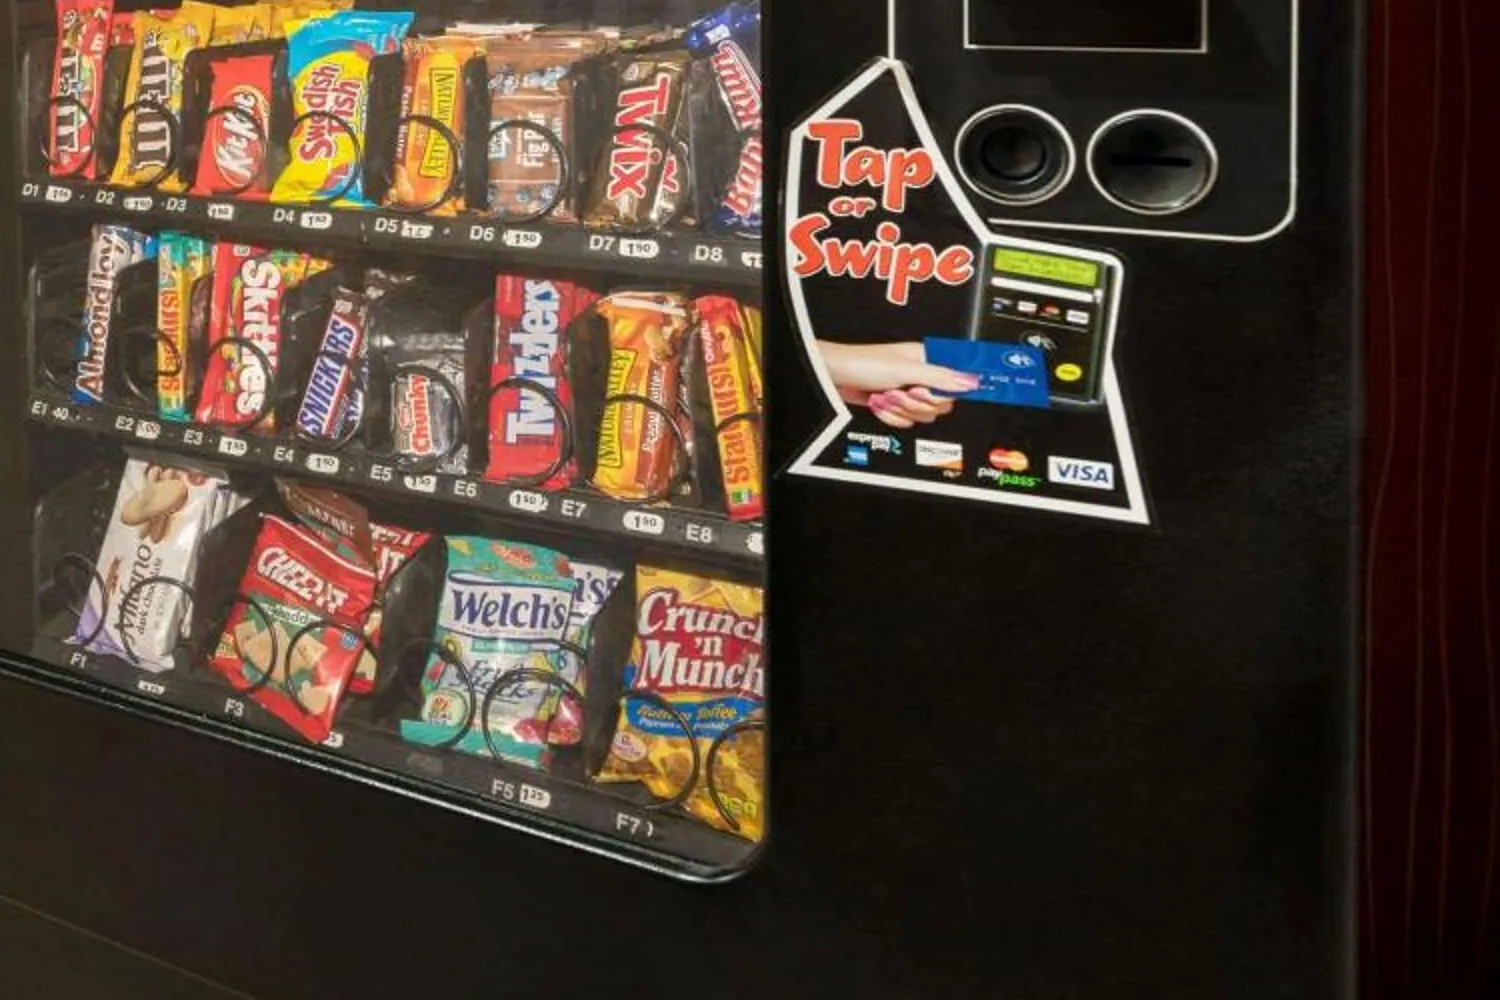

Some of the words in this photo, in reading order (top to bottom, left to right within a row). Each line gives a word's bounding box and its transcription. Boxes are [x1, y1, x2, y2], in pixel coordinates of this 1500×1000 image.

[607, 72, 671, 200] Twix
[807, 118, 937, 213] Tap
[22, 184, 40, 197] D1
[95, 191, 115, 204] D2
[165, 199, 187, 211] D3
[829, 196, 877, 218] or
[273, 208, 295, 223] D4
[374, 218, 398, 232] D5
[469, 226, 494, 241] D6
[590, 234, 615, 251] D7
[695, 245, 723, 261] D8
[788, 213, 975, 305] Swipe
[76, 287, 111, 401] Almond
[235, 259, 281, 415] Skittles
[31, 402, 47, 415] E1
[412, 375, 432, 455] Chunky
[115, 416, 134, 430] E2
[184, 430, 203, 444] E3
[273, 448, 295, 462] E4
[370, 466, 393, 481] E5
[1057, 462, 1109, 484] VISA
[454, 481, 477, 496] E6
[560, 501, 588, 517] E7
[686, 524, 713, 542] E8
[450, 588, 569, 630] Welch's
[69, 653, 87, 669] F1
[638, 639, 764, 696] Munch
[224, 698, 245, 717] F3
[491, 779, 514, 799] F5
[615, 813, 643, 834] F7
